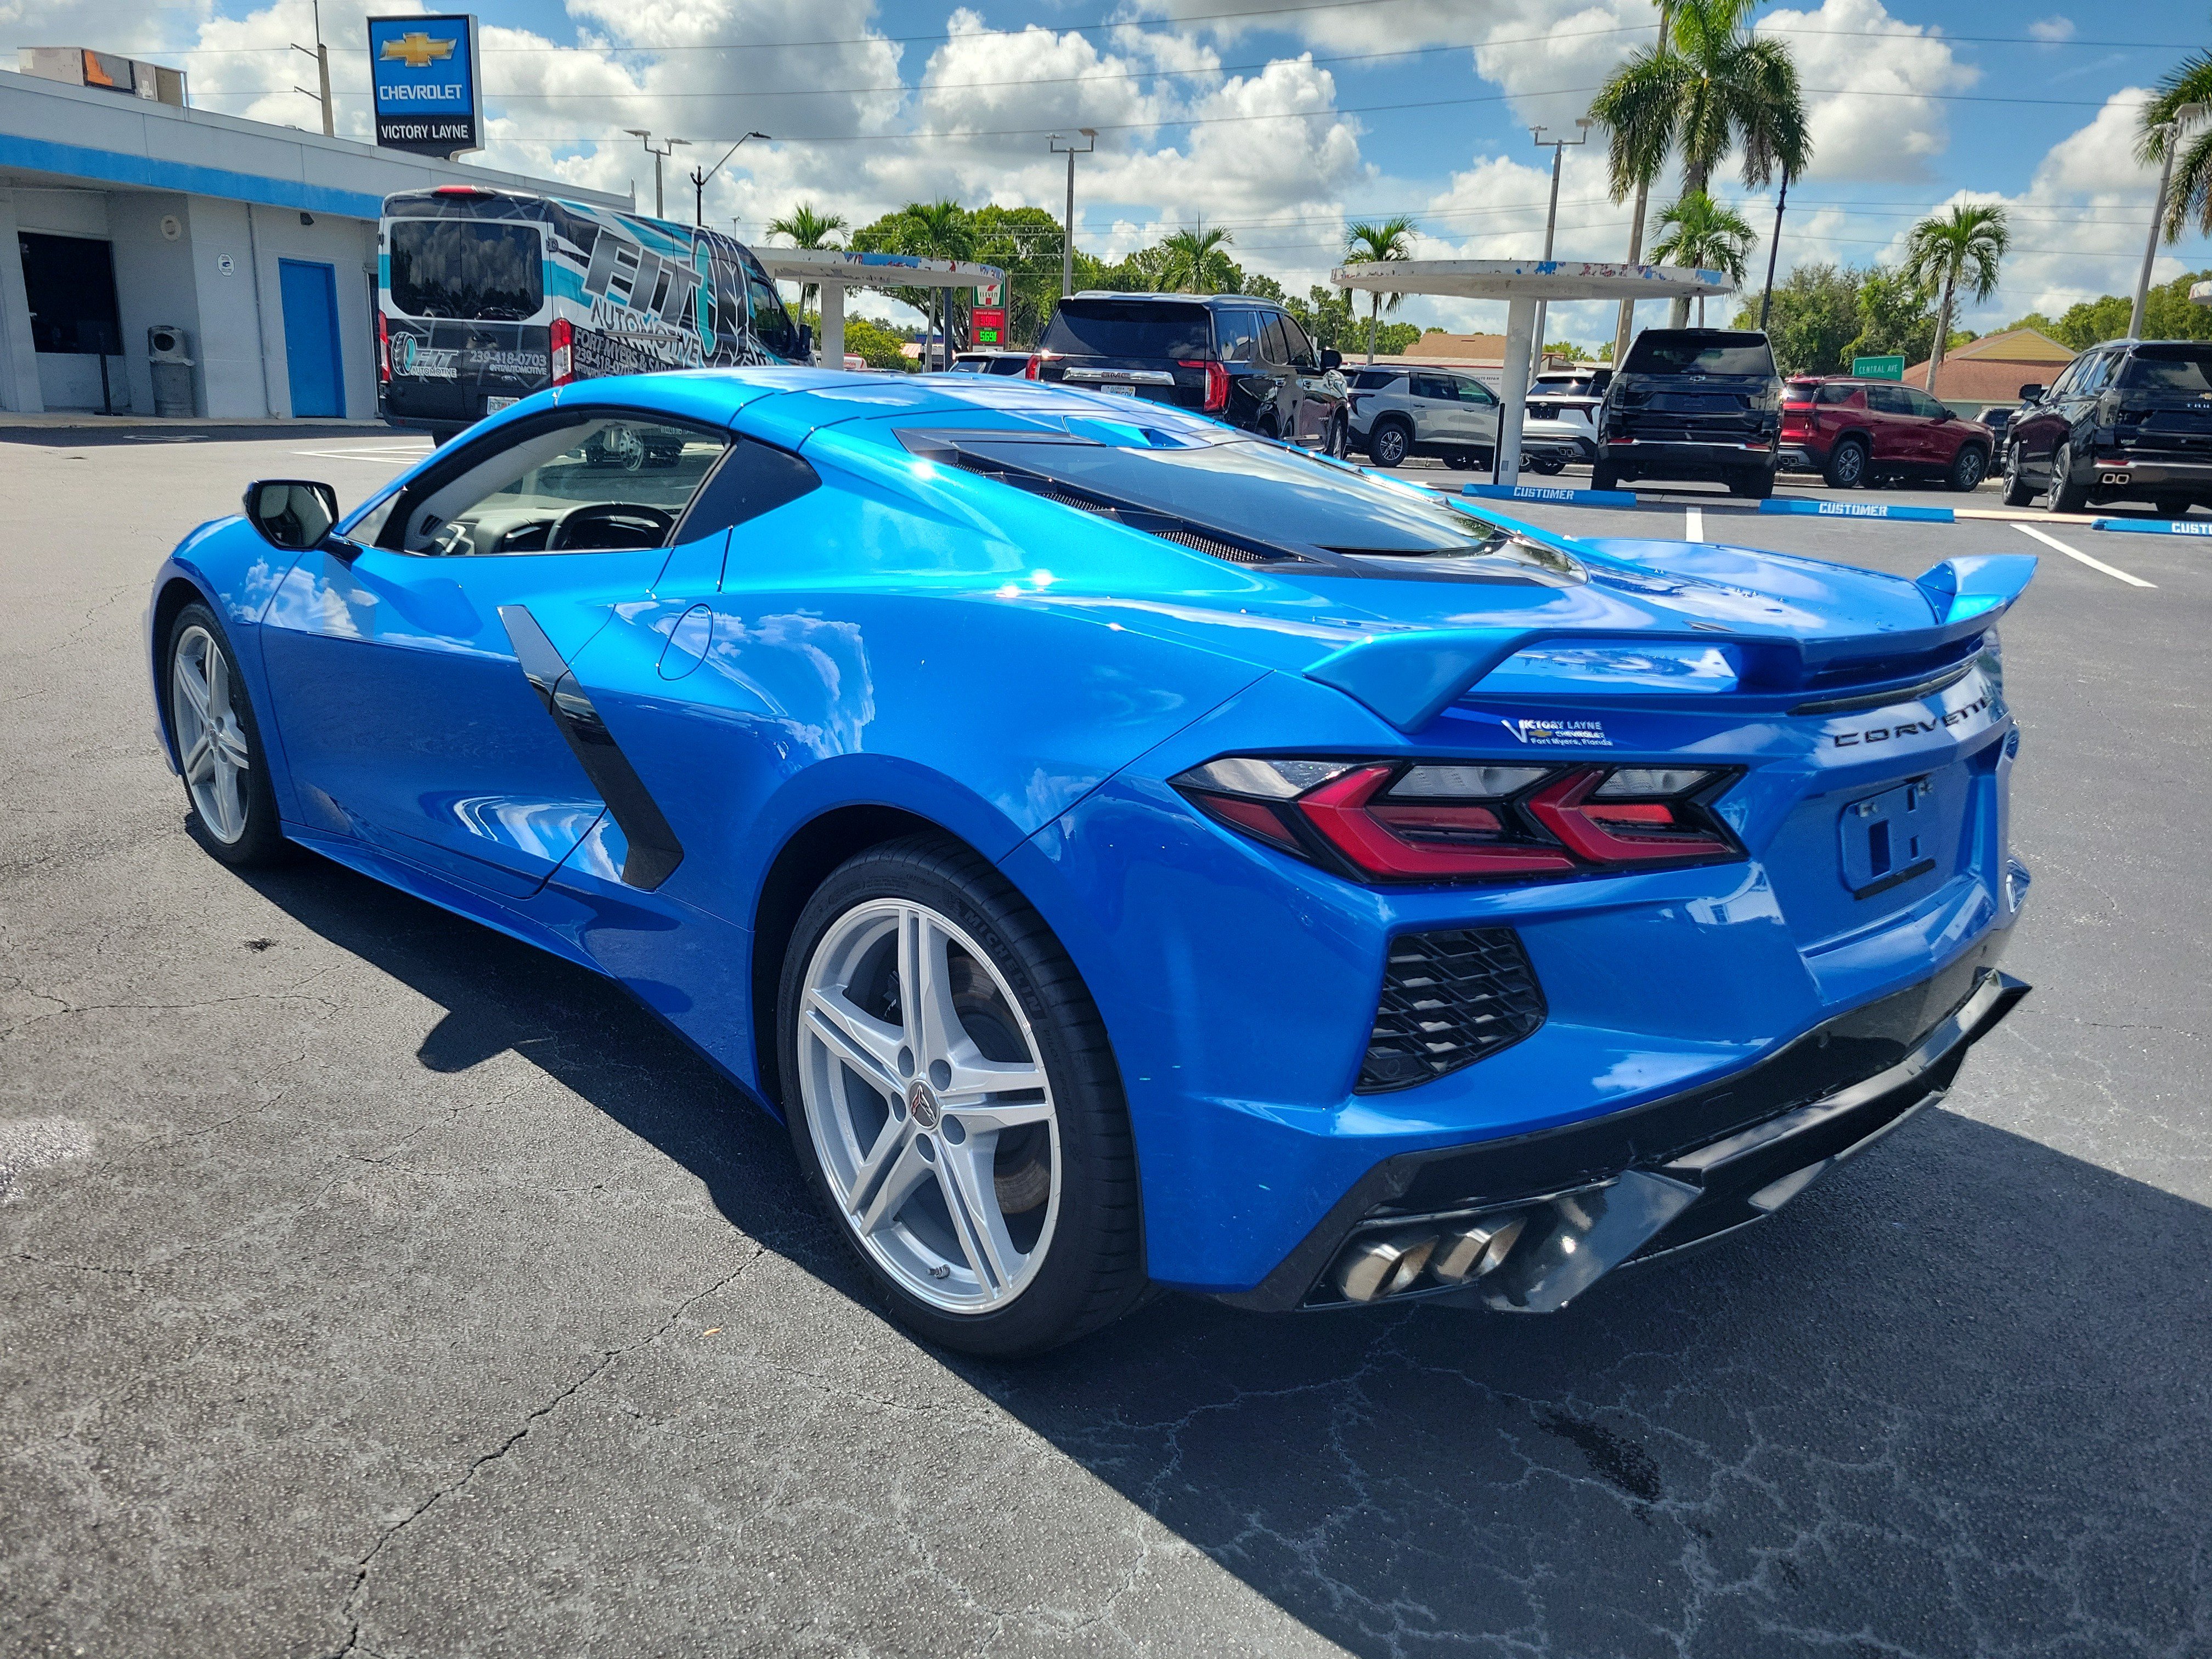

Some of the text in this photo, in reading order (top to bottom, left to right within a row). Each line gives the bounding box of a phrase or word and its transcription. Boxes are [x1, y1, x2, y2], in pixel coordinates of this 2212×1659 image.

[380, 84, 462, 100] CHEVROLET
[381, 125, 469, 139] VICTORY LAYNE
[582, 225, 704, 329] FIT
[574, 326, 604, 354] FORT
[603, 338, 638, 369] MYERS
[413, 348, 459, 368] FIT
[470, 351, 547, 366] 239-418-0703
[410, 366, 458, 379] AUTOMOTIVE
[1859, 363, 1898, 375] CENTRAL AVE
[1514, 487, 1575, 500] CUSTOMER
[1818, 503, 1888, 517] CUSTOMER
[1500, 719, 1603, 743] VICTORY LAYNE
[1554, 730, 1606, 739] CHEVROLET
[1582, 738, 1613, 747] Florida
[964, 911, 1042, 1012] MICHELIN
